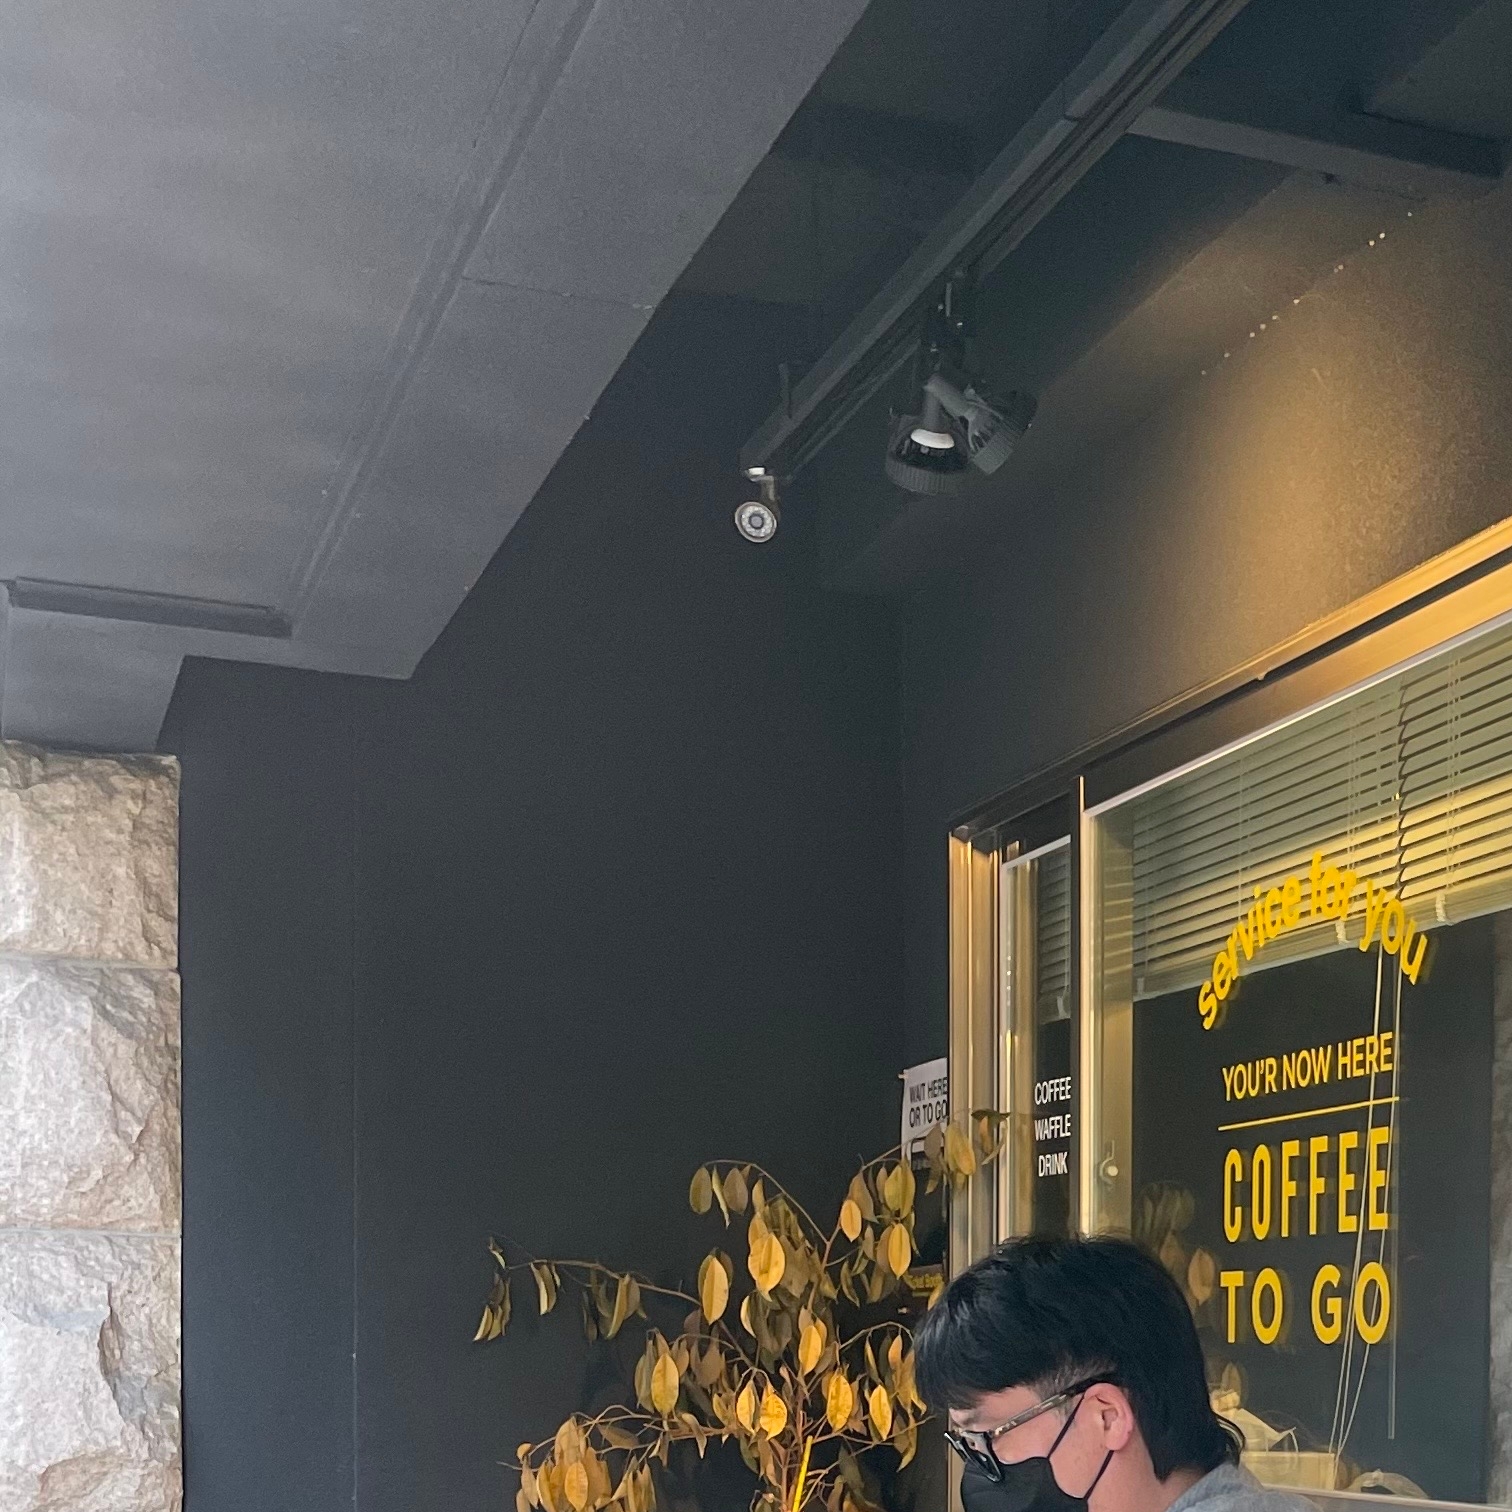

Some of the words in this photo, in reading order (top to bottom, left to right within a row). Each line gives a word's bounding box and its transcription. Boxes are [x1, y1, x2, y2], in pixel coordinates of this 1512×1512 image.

[1199, 876, 1302, 1030] service
[1310, 850, 1357, 921] for
[1359, 880, 1428, 985] you
[1222, 1057, 1277, 1101] YOU'R
[1283, 1045, 1332, 1091] NOW
[1338, 1031, 1393, 1080] HERE
[909, 1083, 926, 1104] WAIT
[928, 1077, 948, 1098] HERE
[1035, 1076, 1072, 1105] COFFEE
[909, 1106, 921, 1128] OR
[922, 1102, 933, 1124] TO
[935, 1099, 948, 1121] GO
[1035, 1114, 1072, 1141] WAFFLE
[1038, 1152, 1068, 1177] DRINK
[1224, 1126, 1389, 1242] COFFEE
[1220, 1268, 1283, 1344] TO
[1311, 1261, 1390, 1344] GO
